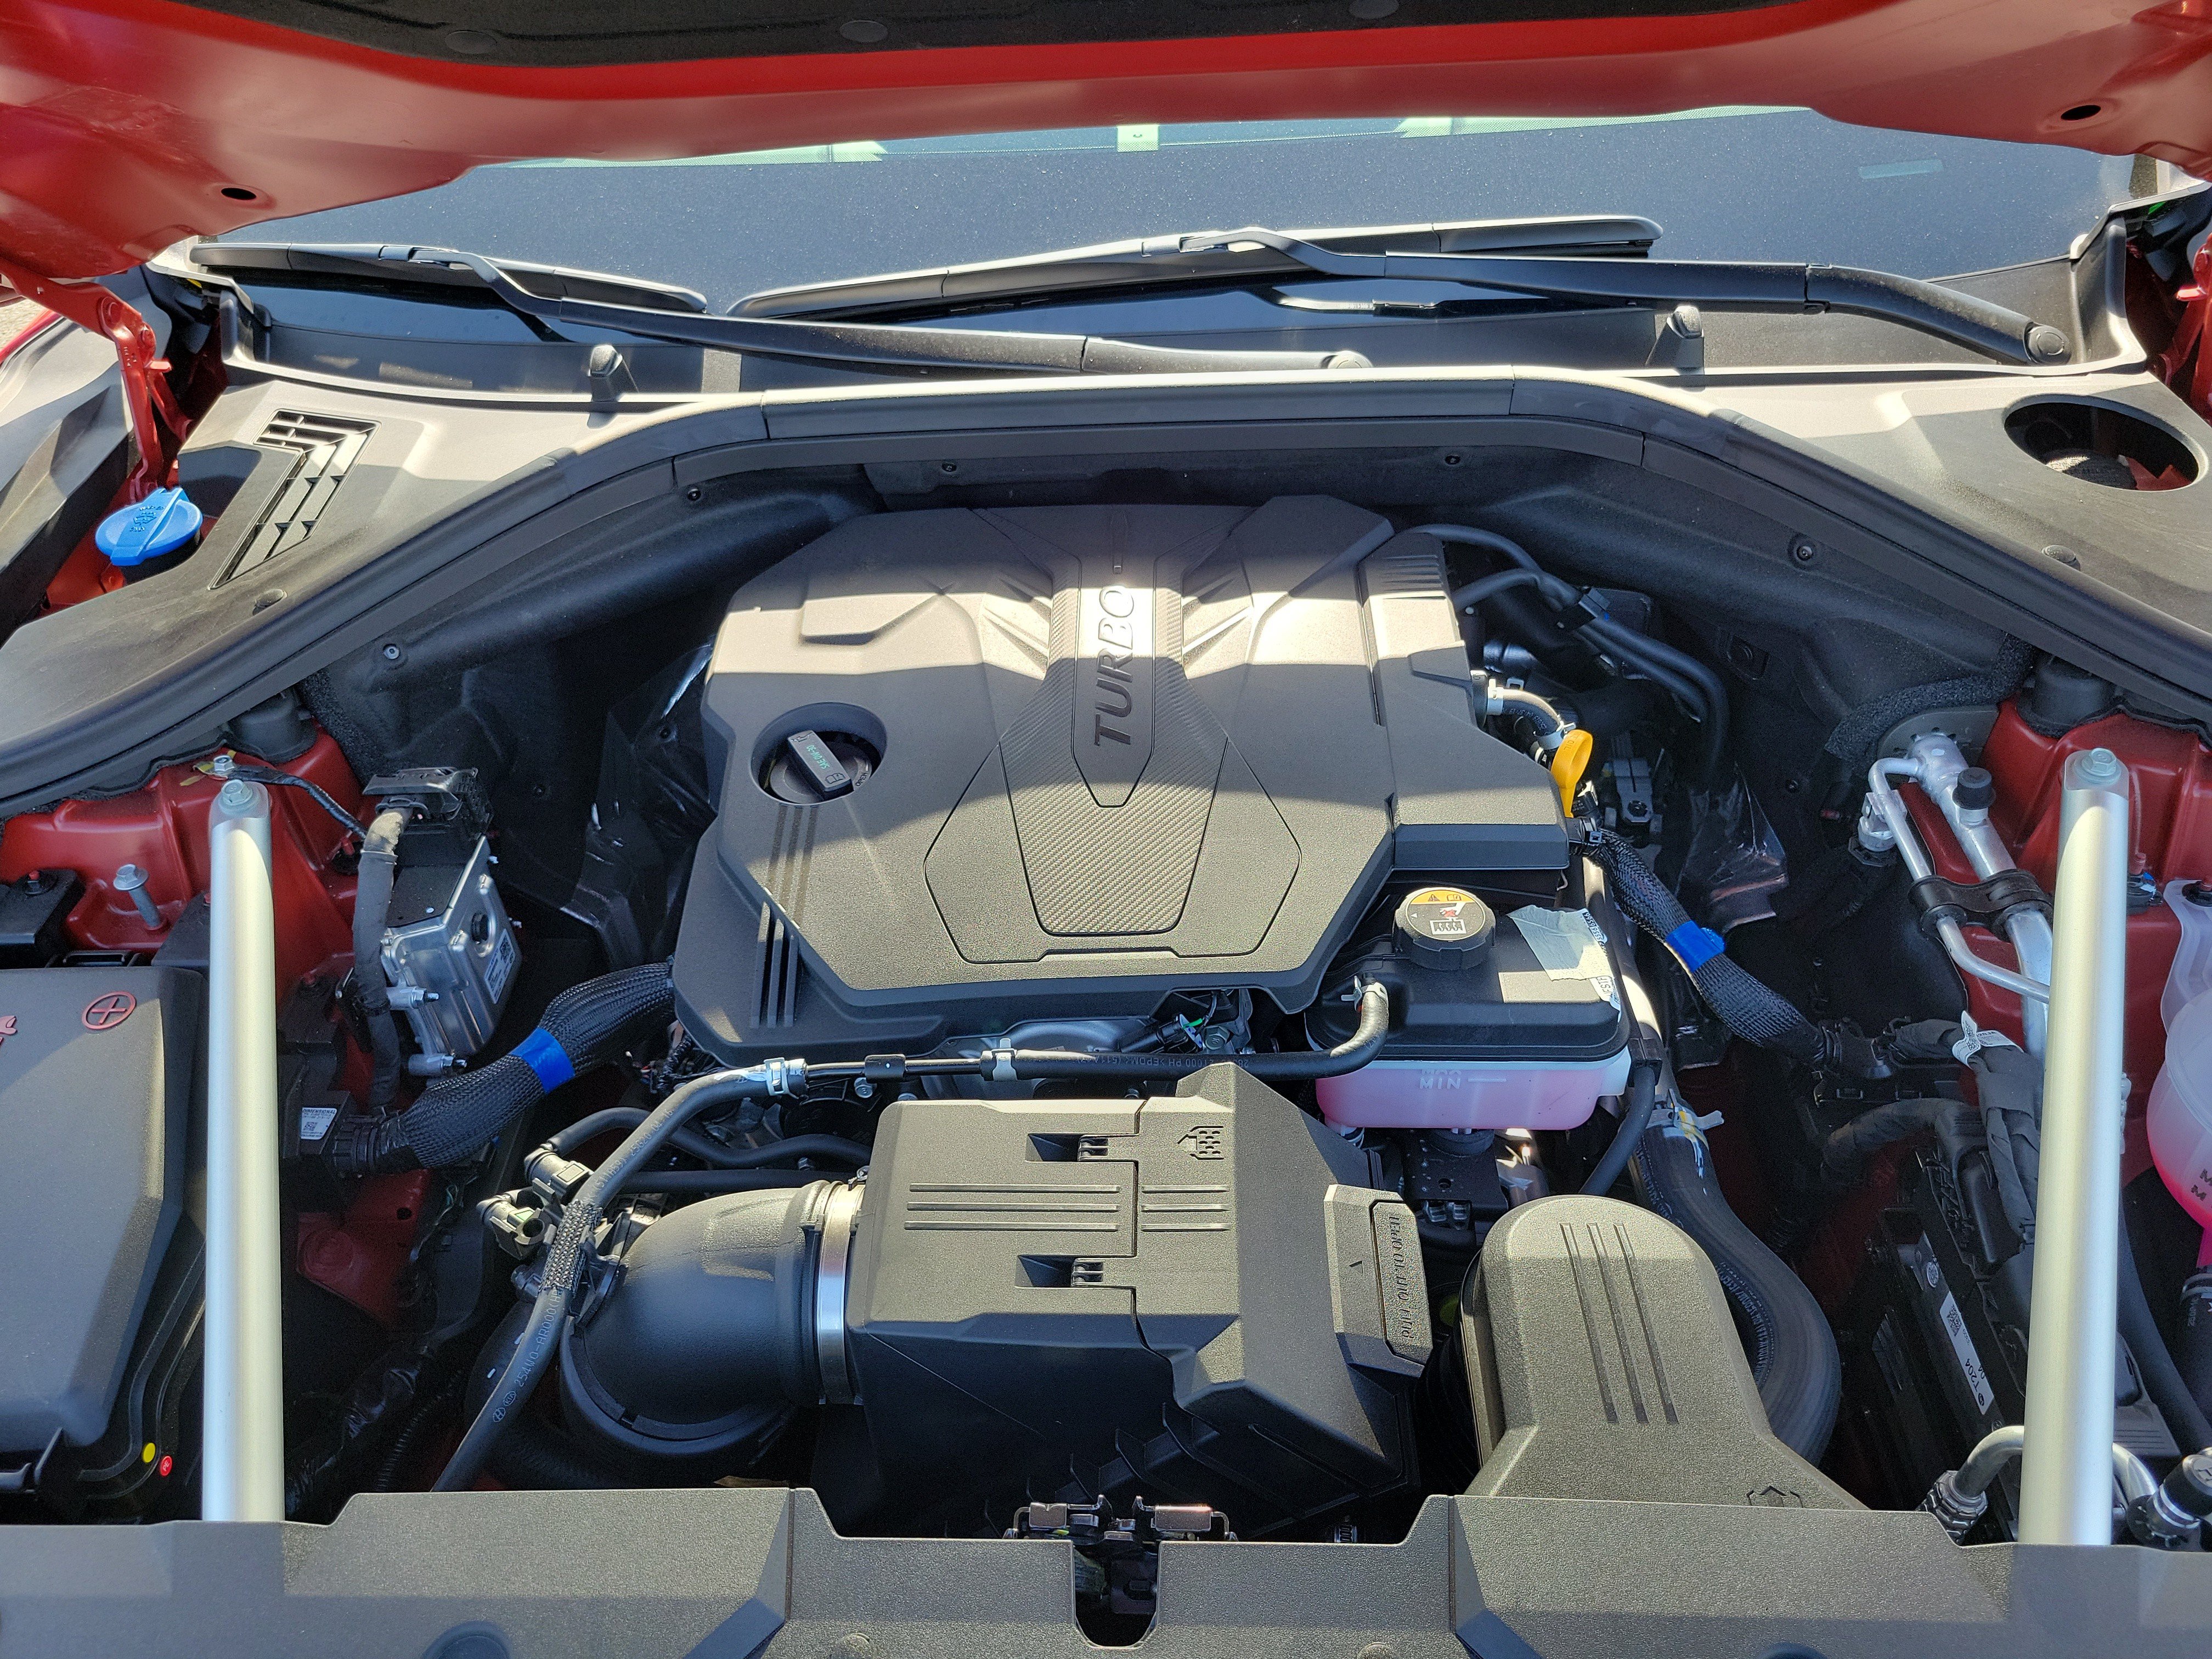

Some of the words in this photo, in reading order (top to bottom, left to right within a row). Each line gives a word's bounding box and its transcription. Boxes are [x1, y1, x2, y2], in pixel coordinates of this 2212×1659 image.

[1094, 585, 1135, 746] TURBO
[817, 758, 830, 771] SAE
[1419, 1077, 1462, 1090] MIN
[1389, 1216, 1402, 1250] OPEN
[1393, 1254, 1406, 1272] TO
[1398, 1307, 1414, 1338] PULL
[1965, 1358, 1979, 1392] T204
